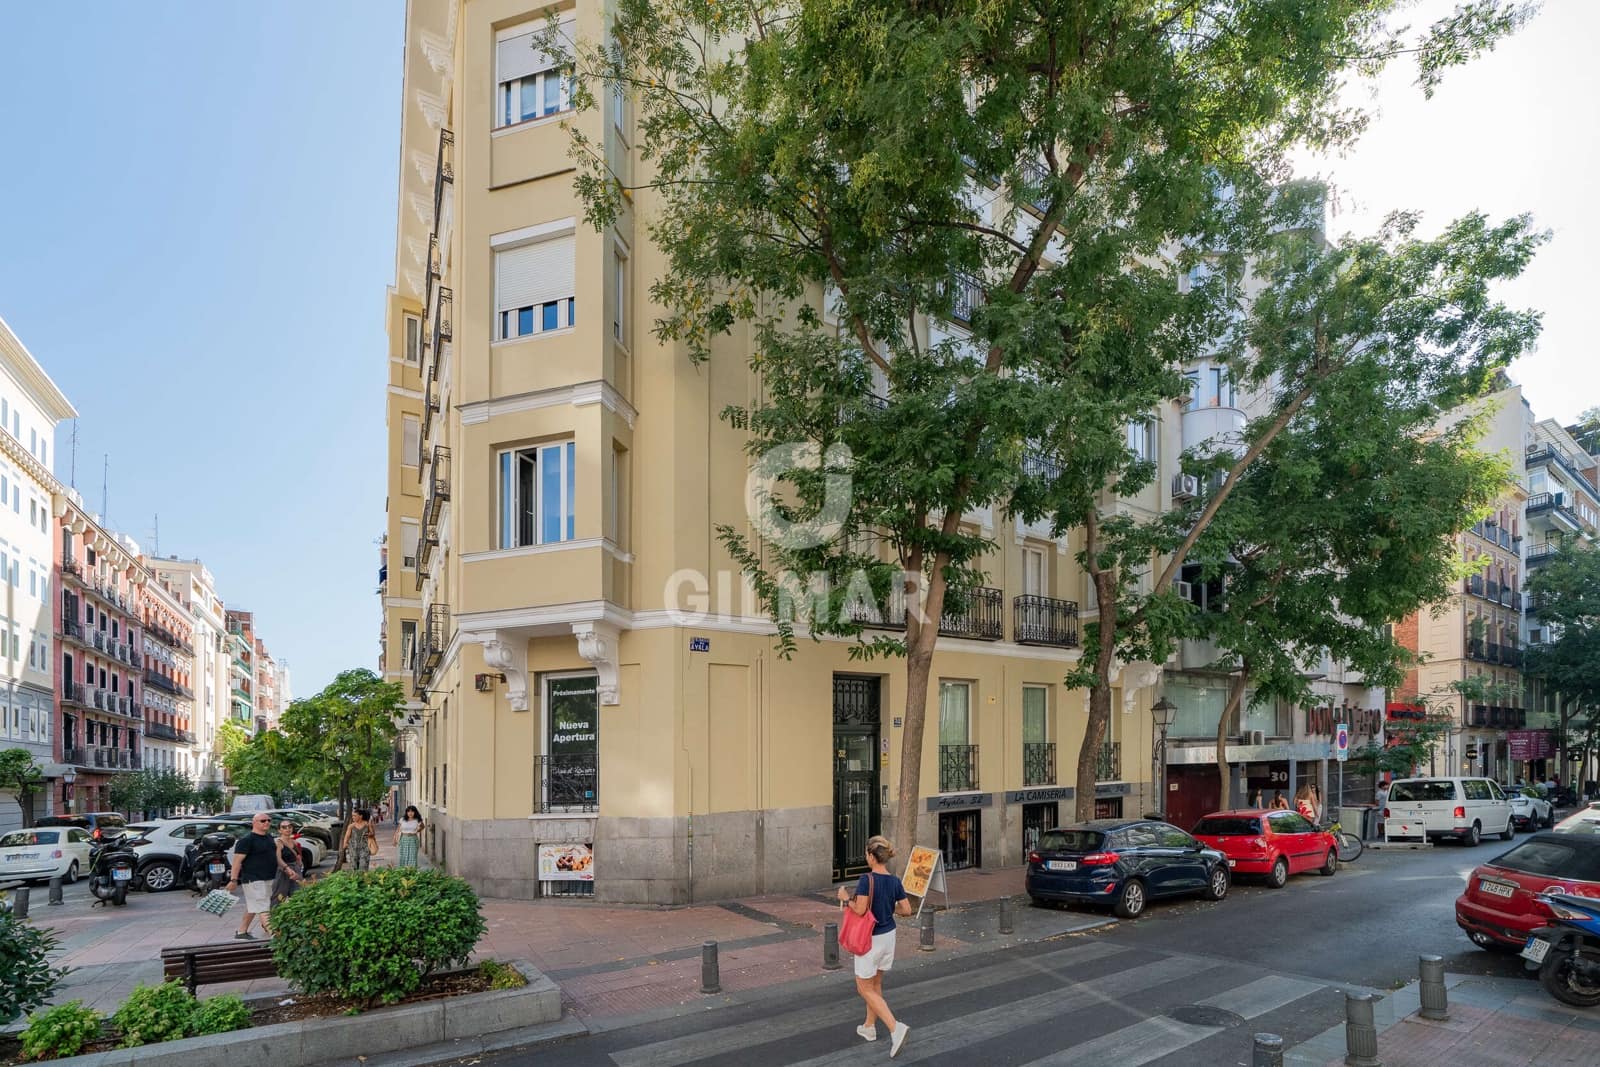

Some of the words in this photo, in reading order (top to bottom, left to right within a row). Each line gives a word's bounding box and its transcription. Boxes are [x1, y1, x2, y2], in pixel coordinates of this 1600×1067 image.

[560, 721, 589, 730] Nueva
[553, 733, 596, 743] Apertura
[1271, 771, 1288, 782] 30
[1014, 792, 1025, 802] LA
[1026, 789, 1067, 801] CAMISERIA
[938, 797, 965, 808] Ayala
[970, 796, 984, 805] 32
